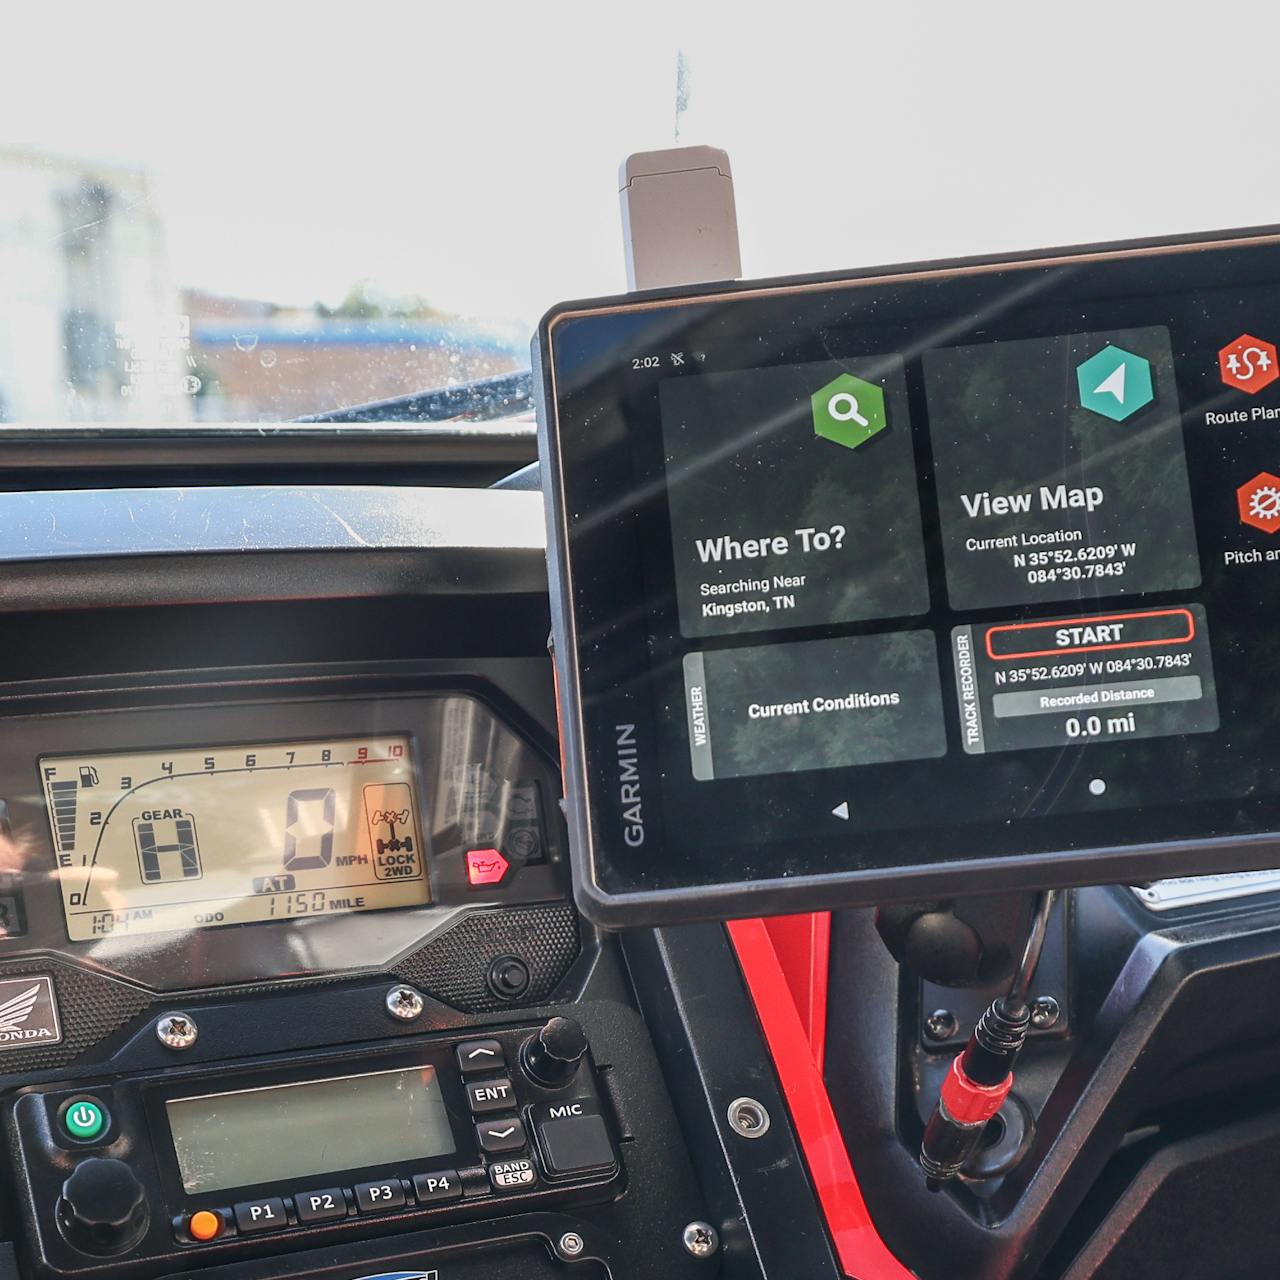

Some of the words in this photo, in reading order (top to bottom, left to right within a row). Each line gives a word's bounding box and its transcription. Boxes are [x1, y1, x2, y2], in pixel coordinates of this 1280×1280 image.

[631, 356, 660, 369] 2:02
[1205, 409, 1249, 426] Route
[961, 491, 1032, 518] View
[1039, 484, 1104, 512] Map
[696, 533, 789, 566] Where
[795, 525, 847, 553] To?
[965, 534, 1018, 551] Current
[1021, 530, 1083, 547] Location
[1013, 554, 1026, 568] N
[1121, 543, 1137, 556] W
[1223, 547, 1263, 565] Pitch
[700, 577, 771, 597] Searching
[773, 574, 807, 589] Near
[702, 599, 771, 618] Kingston,
[772, 595, 796, 610] TN
[1055, 624, 1124, 647] START
[956, 633, 975, 698] RECORDER
[994, 671, 1008, 685] N
[1089, 662, 1104, 675] W
[747, 699, 810, 719] Current
[812, 691, 901, 713] Conditions
[1039, 689, 1099, 708] Recorded
[1101, 687, 1155, 703] Distance
[690, 685, 707, 747] WEATHER
[961, 702, 979, 745] TRACK
[1065, 715, 1102, 738] 0.0
[1107, 712, 1137, 734] mi
[44, 767, 56, 781] F
[90, 811, 102, 825] 2
[121, 777, 132, 790] 3
[161, 761, 173, 774] 4
[204, 757, 215, 770] 5
[245, 754, 256, 767] 6
[286, 751, 295, 764] 7
[321, 749, 331, 762] 8
[357, 747, 368, 760] 9
[388, 745, 403, 758] 10
[615, 723, 645, 848] GARMIN
[141, 808, 183, 821] GEAR
[283, 787, 337, 872] 0
[59, 853, 72, 868] E
[137, 820, 200, 881] H
[335, 854, 369, 867] MPH
[377, 854, 416, 867] LOCK
[384, 864, 414, 878] 2WD
[261, 876, 288, 893] AT
[270, 891, 325, 916] 1150
[329, 897, 366, 911] MILE
[133, 908, 153, 921] AM
[194, 911, 225, 924] ODO
[474, 1085, 508, 1102] ENT
[549, 1104, 583, 1118] MIC
[494, 1161, 529, 1175] BAND
[503, 1171, 529, 1184] ESC
[369, 1184, 394, 1203] P3
[426, 1176, 451, 1194] P4
[309, 1192, 335, 1212] P2
[249, 1203, 275, 1222] P1
